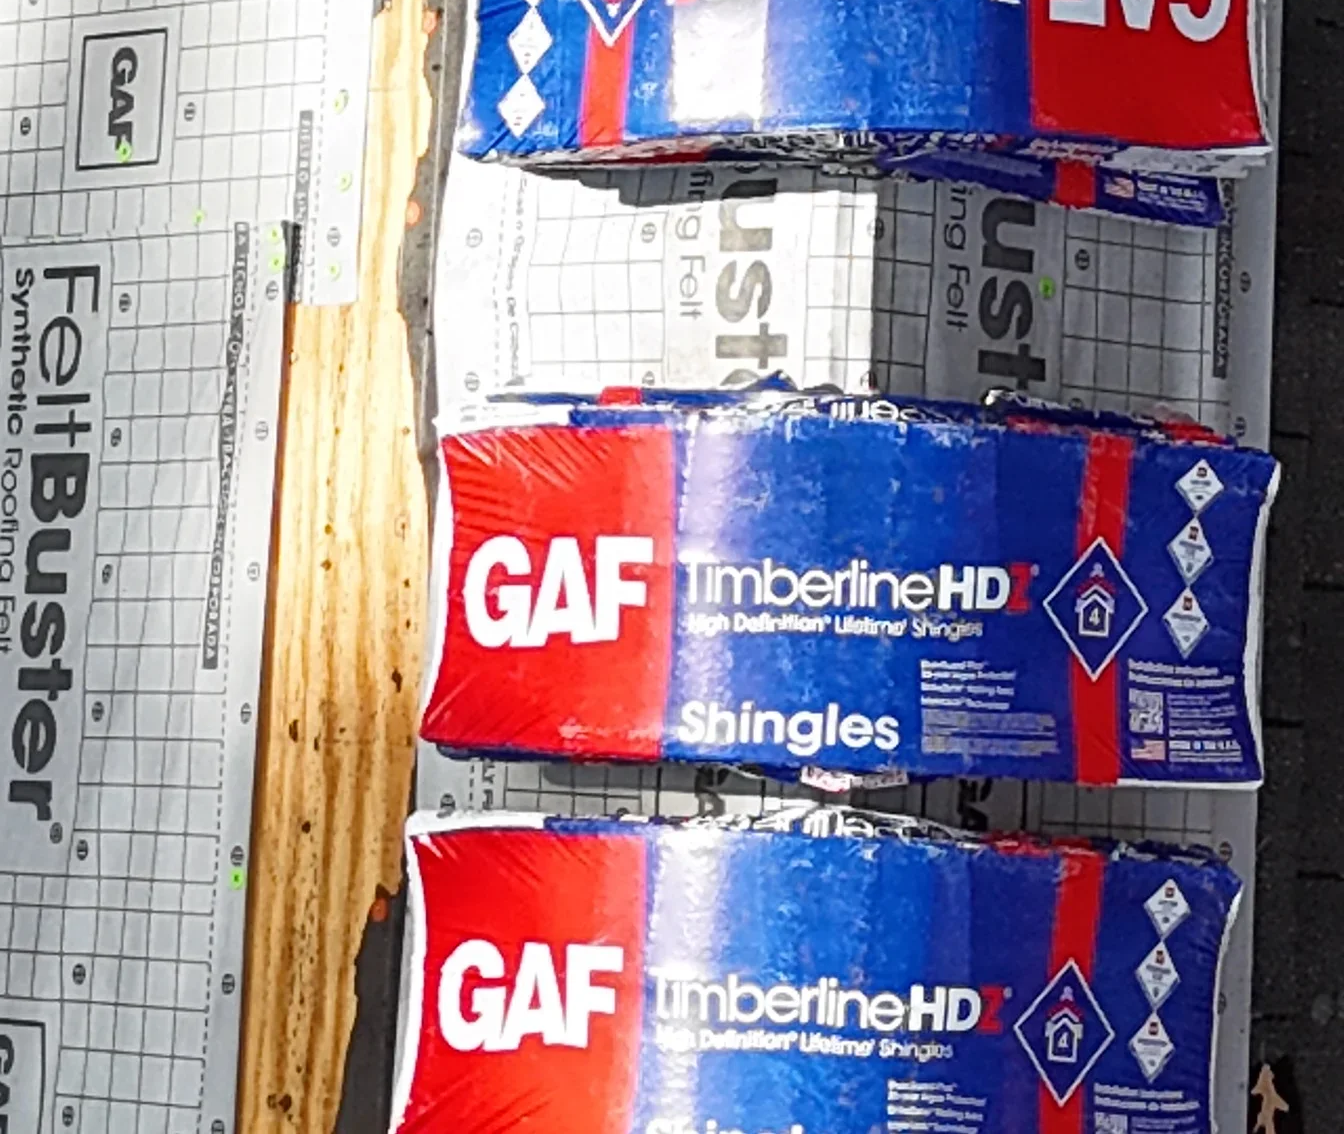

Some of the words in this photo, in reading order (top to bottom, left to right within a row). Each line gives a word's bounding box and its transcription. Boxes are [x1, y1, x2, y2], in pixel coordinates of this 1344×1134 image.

[679, 256, 706, 320] Felt
[945, 264, 971, 332] Felt
[7, 268, 36, 437] Synthetic
[464, 536, 653, 647] GAF
[678, 700, 901, 758] Shingles
[439, 939, 624, 1052] GAF
